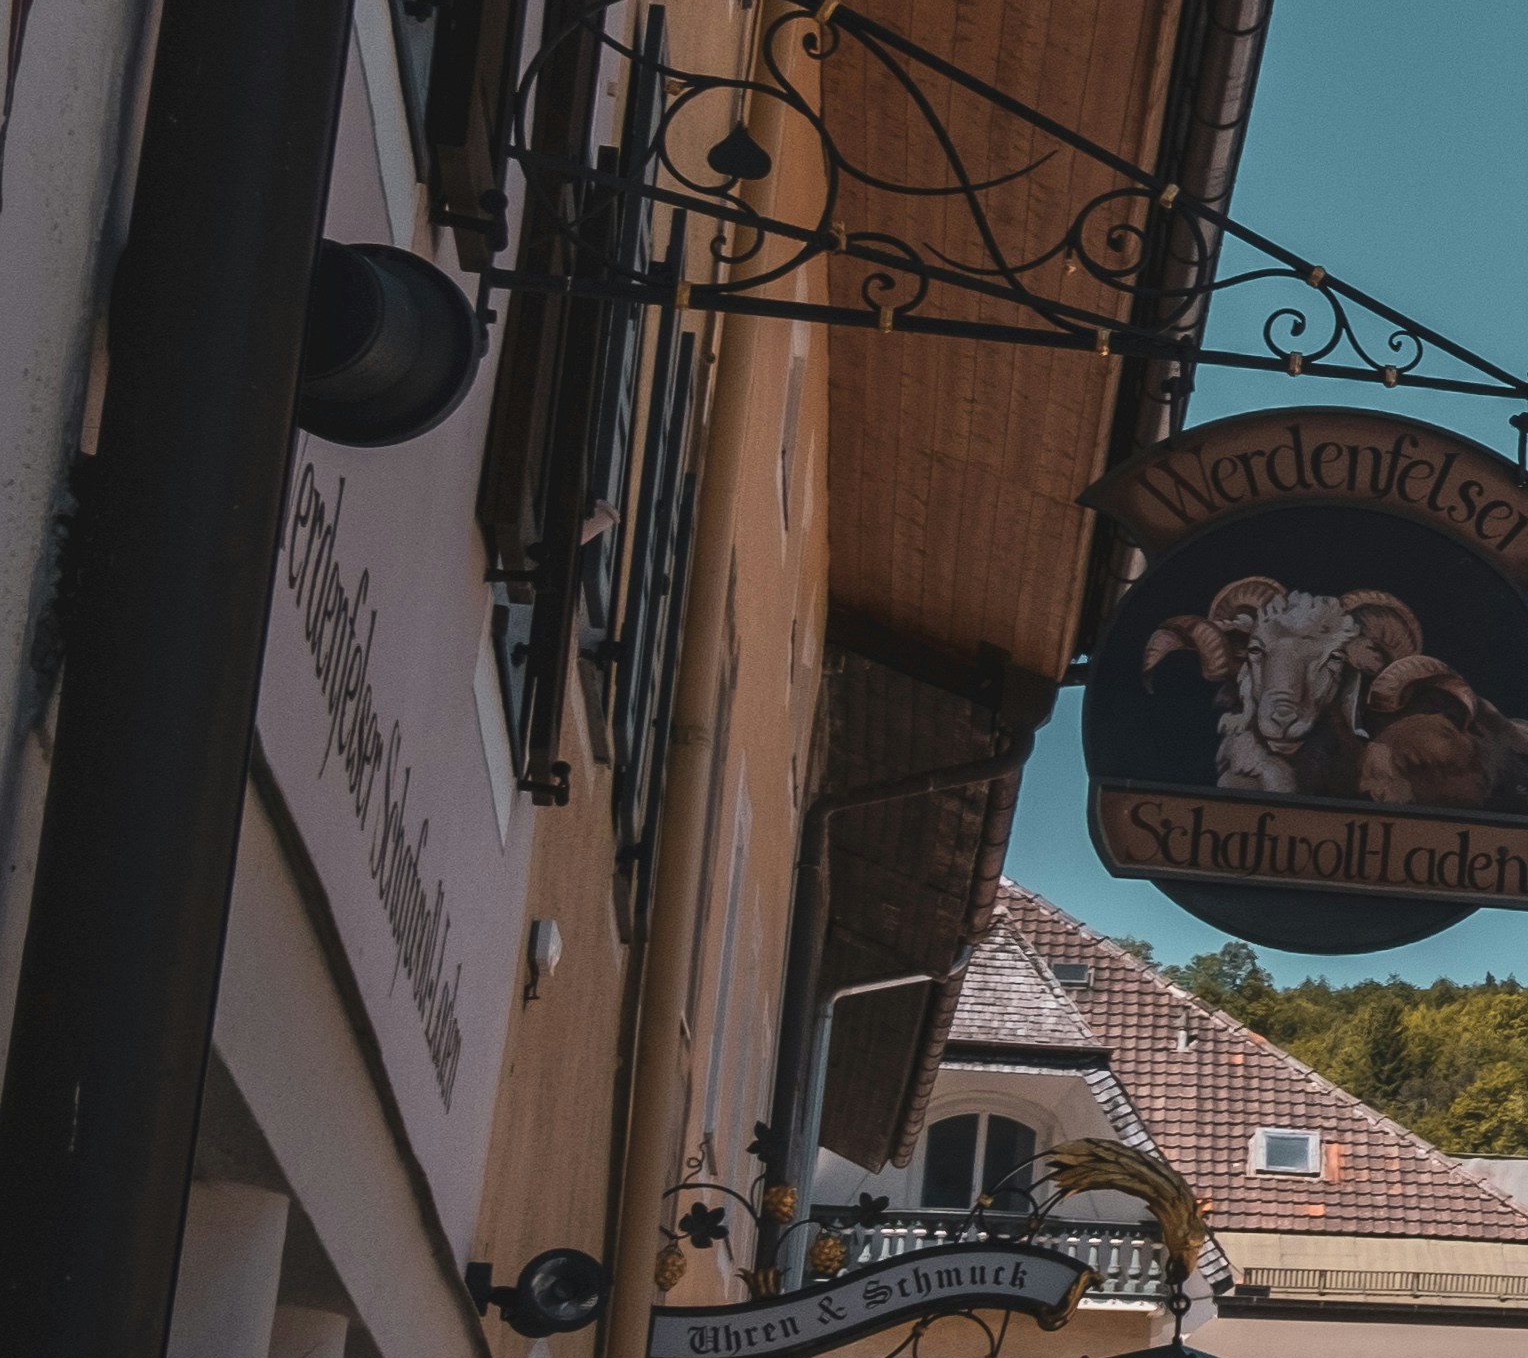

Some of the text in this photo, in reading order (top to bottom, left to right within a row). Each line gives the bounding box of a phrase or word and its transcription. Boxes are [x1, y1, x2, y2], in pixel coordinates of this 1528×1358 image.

[279, 461, 385, 831] erdenfelser
[688, 1260, 1029, 1357] Uhren & Schmuck
